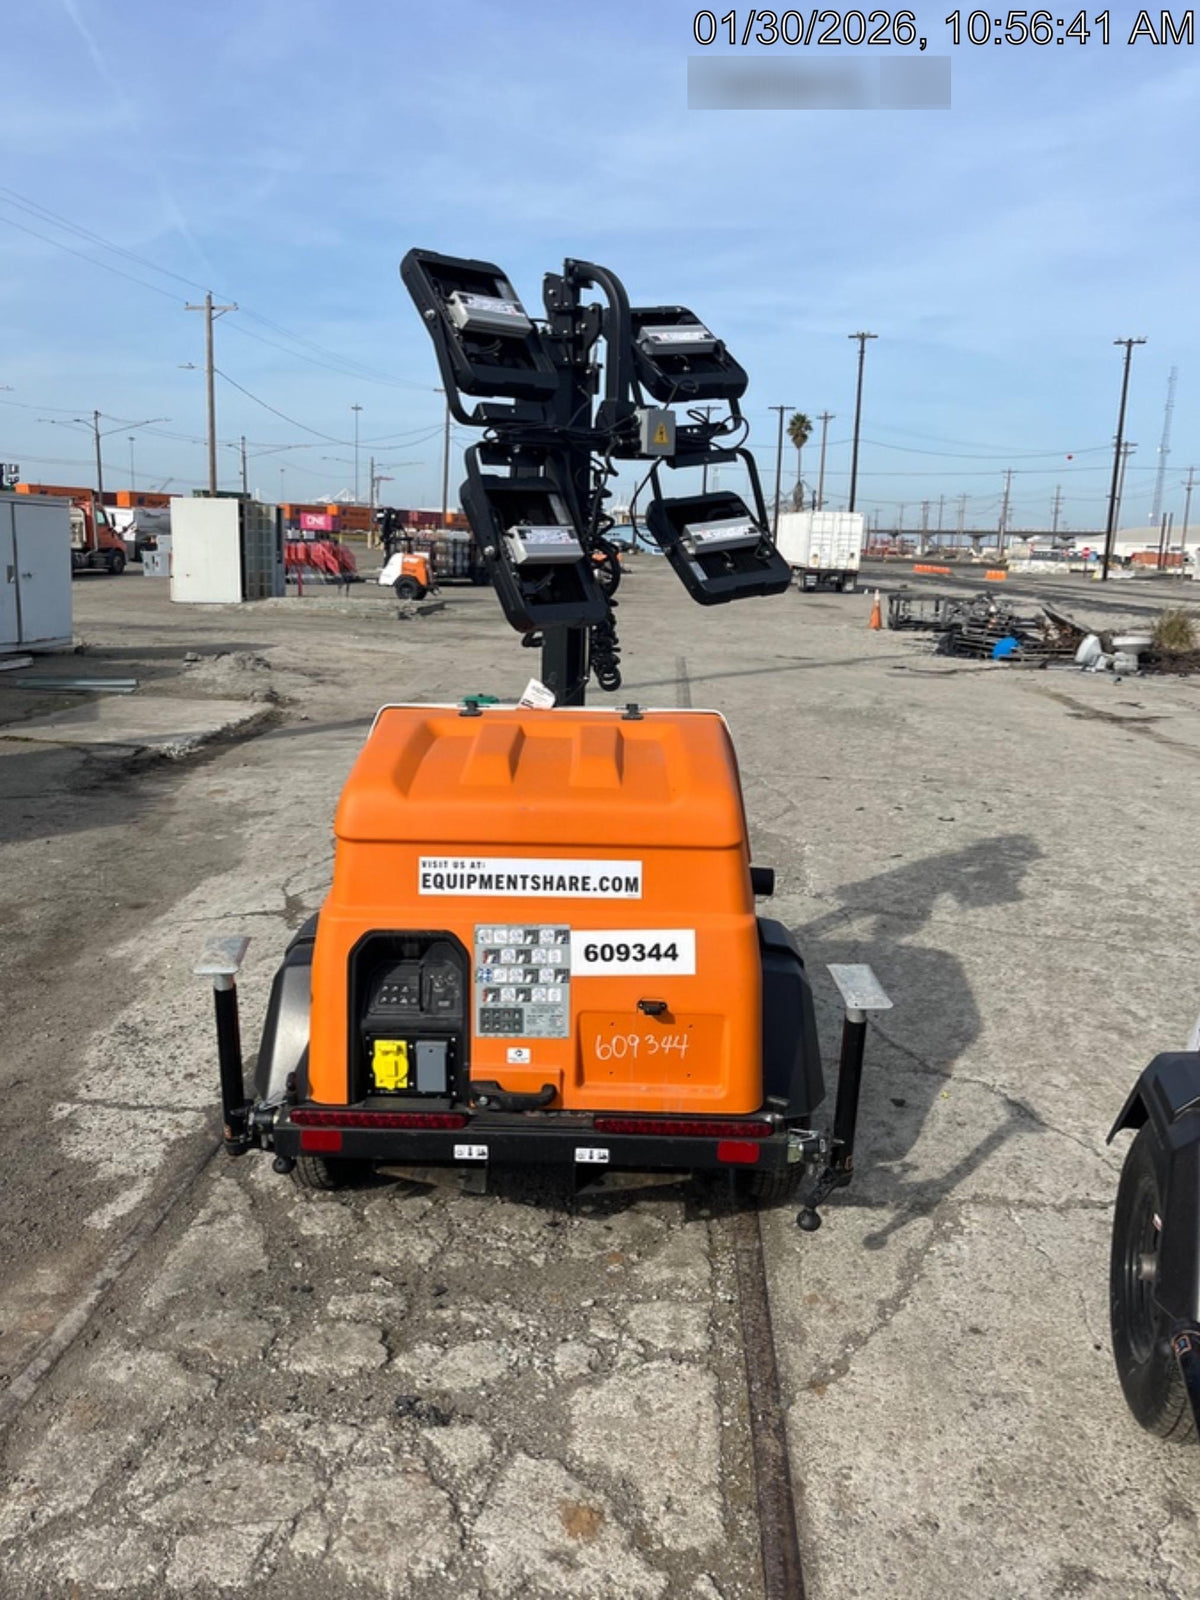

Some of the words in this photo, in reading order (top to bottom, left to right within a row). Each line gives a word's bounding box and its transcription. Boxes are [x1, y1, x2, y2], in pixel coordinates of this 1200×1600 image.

[306, 515, 326, 525] ONE
[421, 860, 448, 868] VISIT
[453, 861, 465, 869] US
[470, 861, 486, 869] AT:
[421, 872, 639, 893] EQUIPMENTSHARE.COM
[584, 943, 679, 962] 609344
